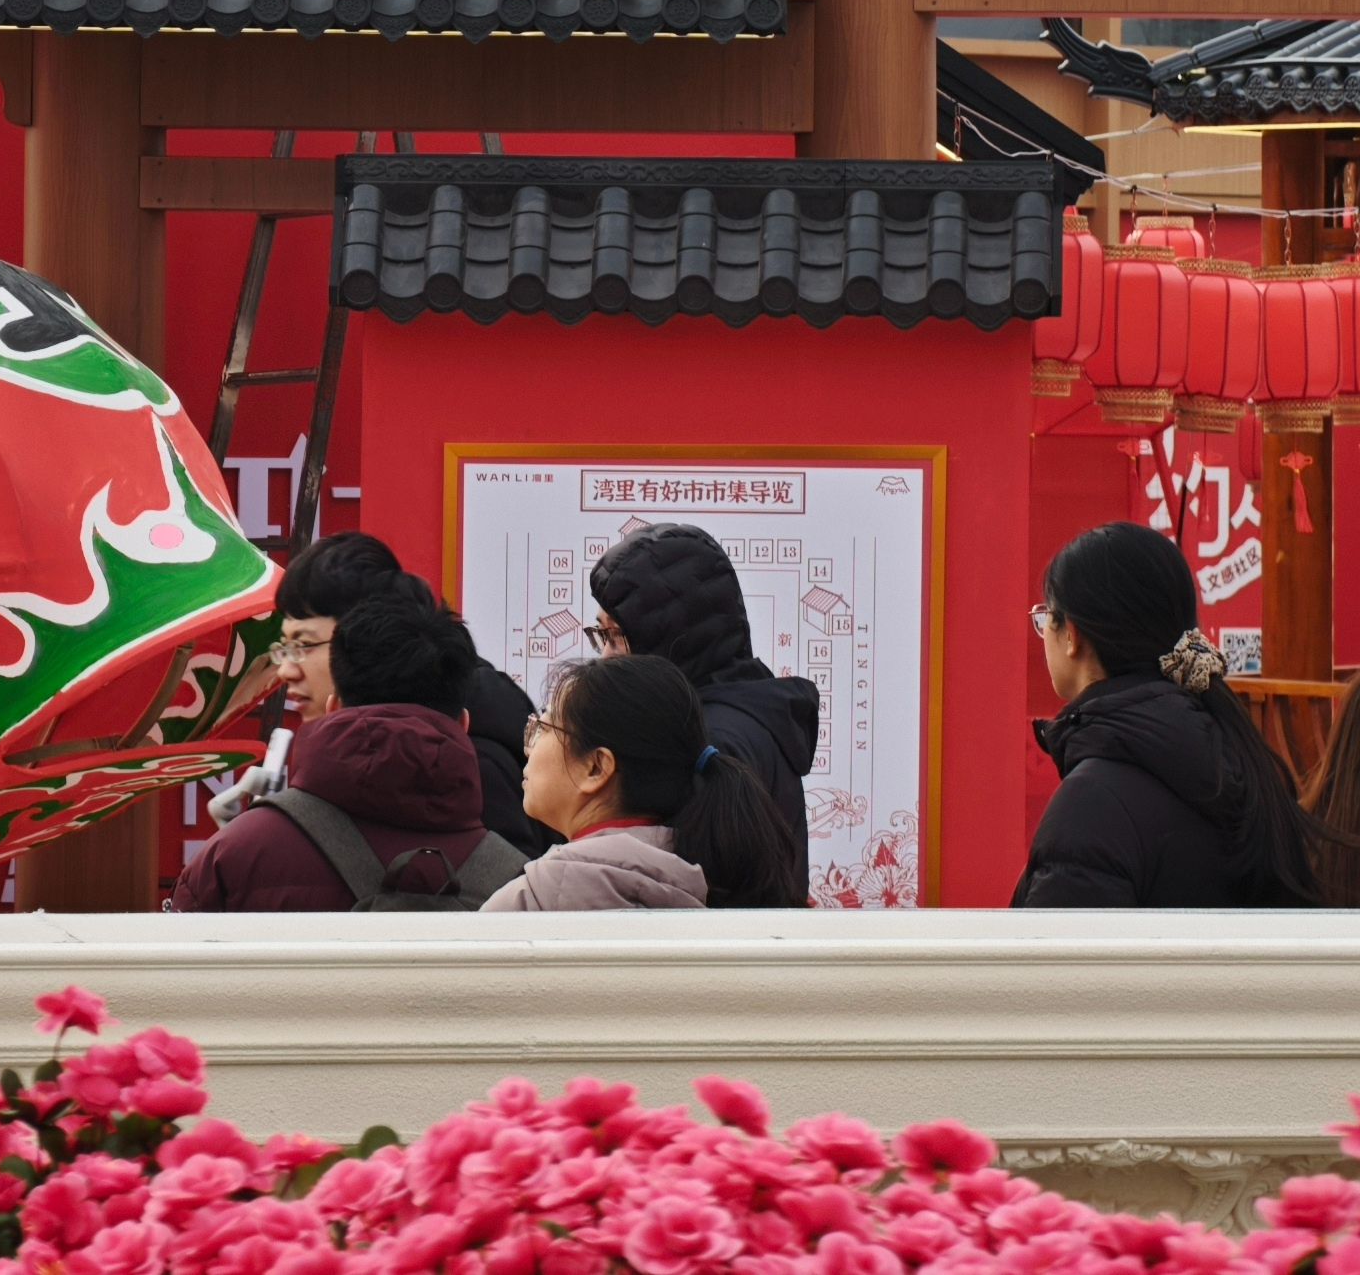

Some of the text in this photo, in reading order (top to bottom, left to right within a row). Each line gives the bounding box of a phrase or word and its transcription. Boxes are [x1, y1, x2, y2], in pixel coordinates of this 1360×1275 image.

[593, 478, 794, 505] 湾里有好市市集导览
[589, 544, 604, 555] 09
[727, 546, 740, 557] 11
[754, 546, 769, 558] 12
[783, 546, 797, 558] 13
[553, 556, 569, 568] 08
[814, 566, 827, 577] 14
[553, 588, 568, 599] 07
[836, 619, 850, 631] 15
[531, 641, 547, 653] 06
[813, 645, 828, 658] 16
[813, 674, 827, 686] 17
[856, 623, 869, 751] TINGYUN
[819, 701, 827, 713] 8
[819, 728, 827, 740] 9
